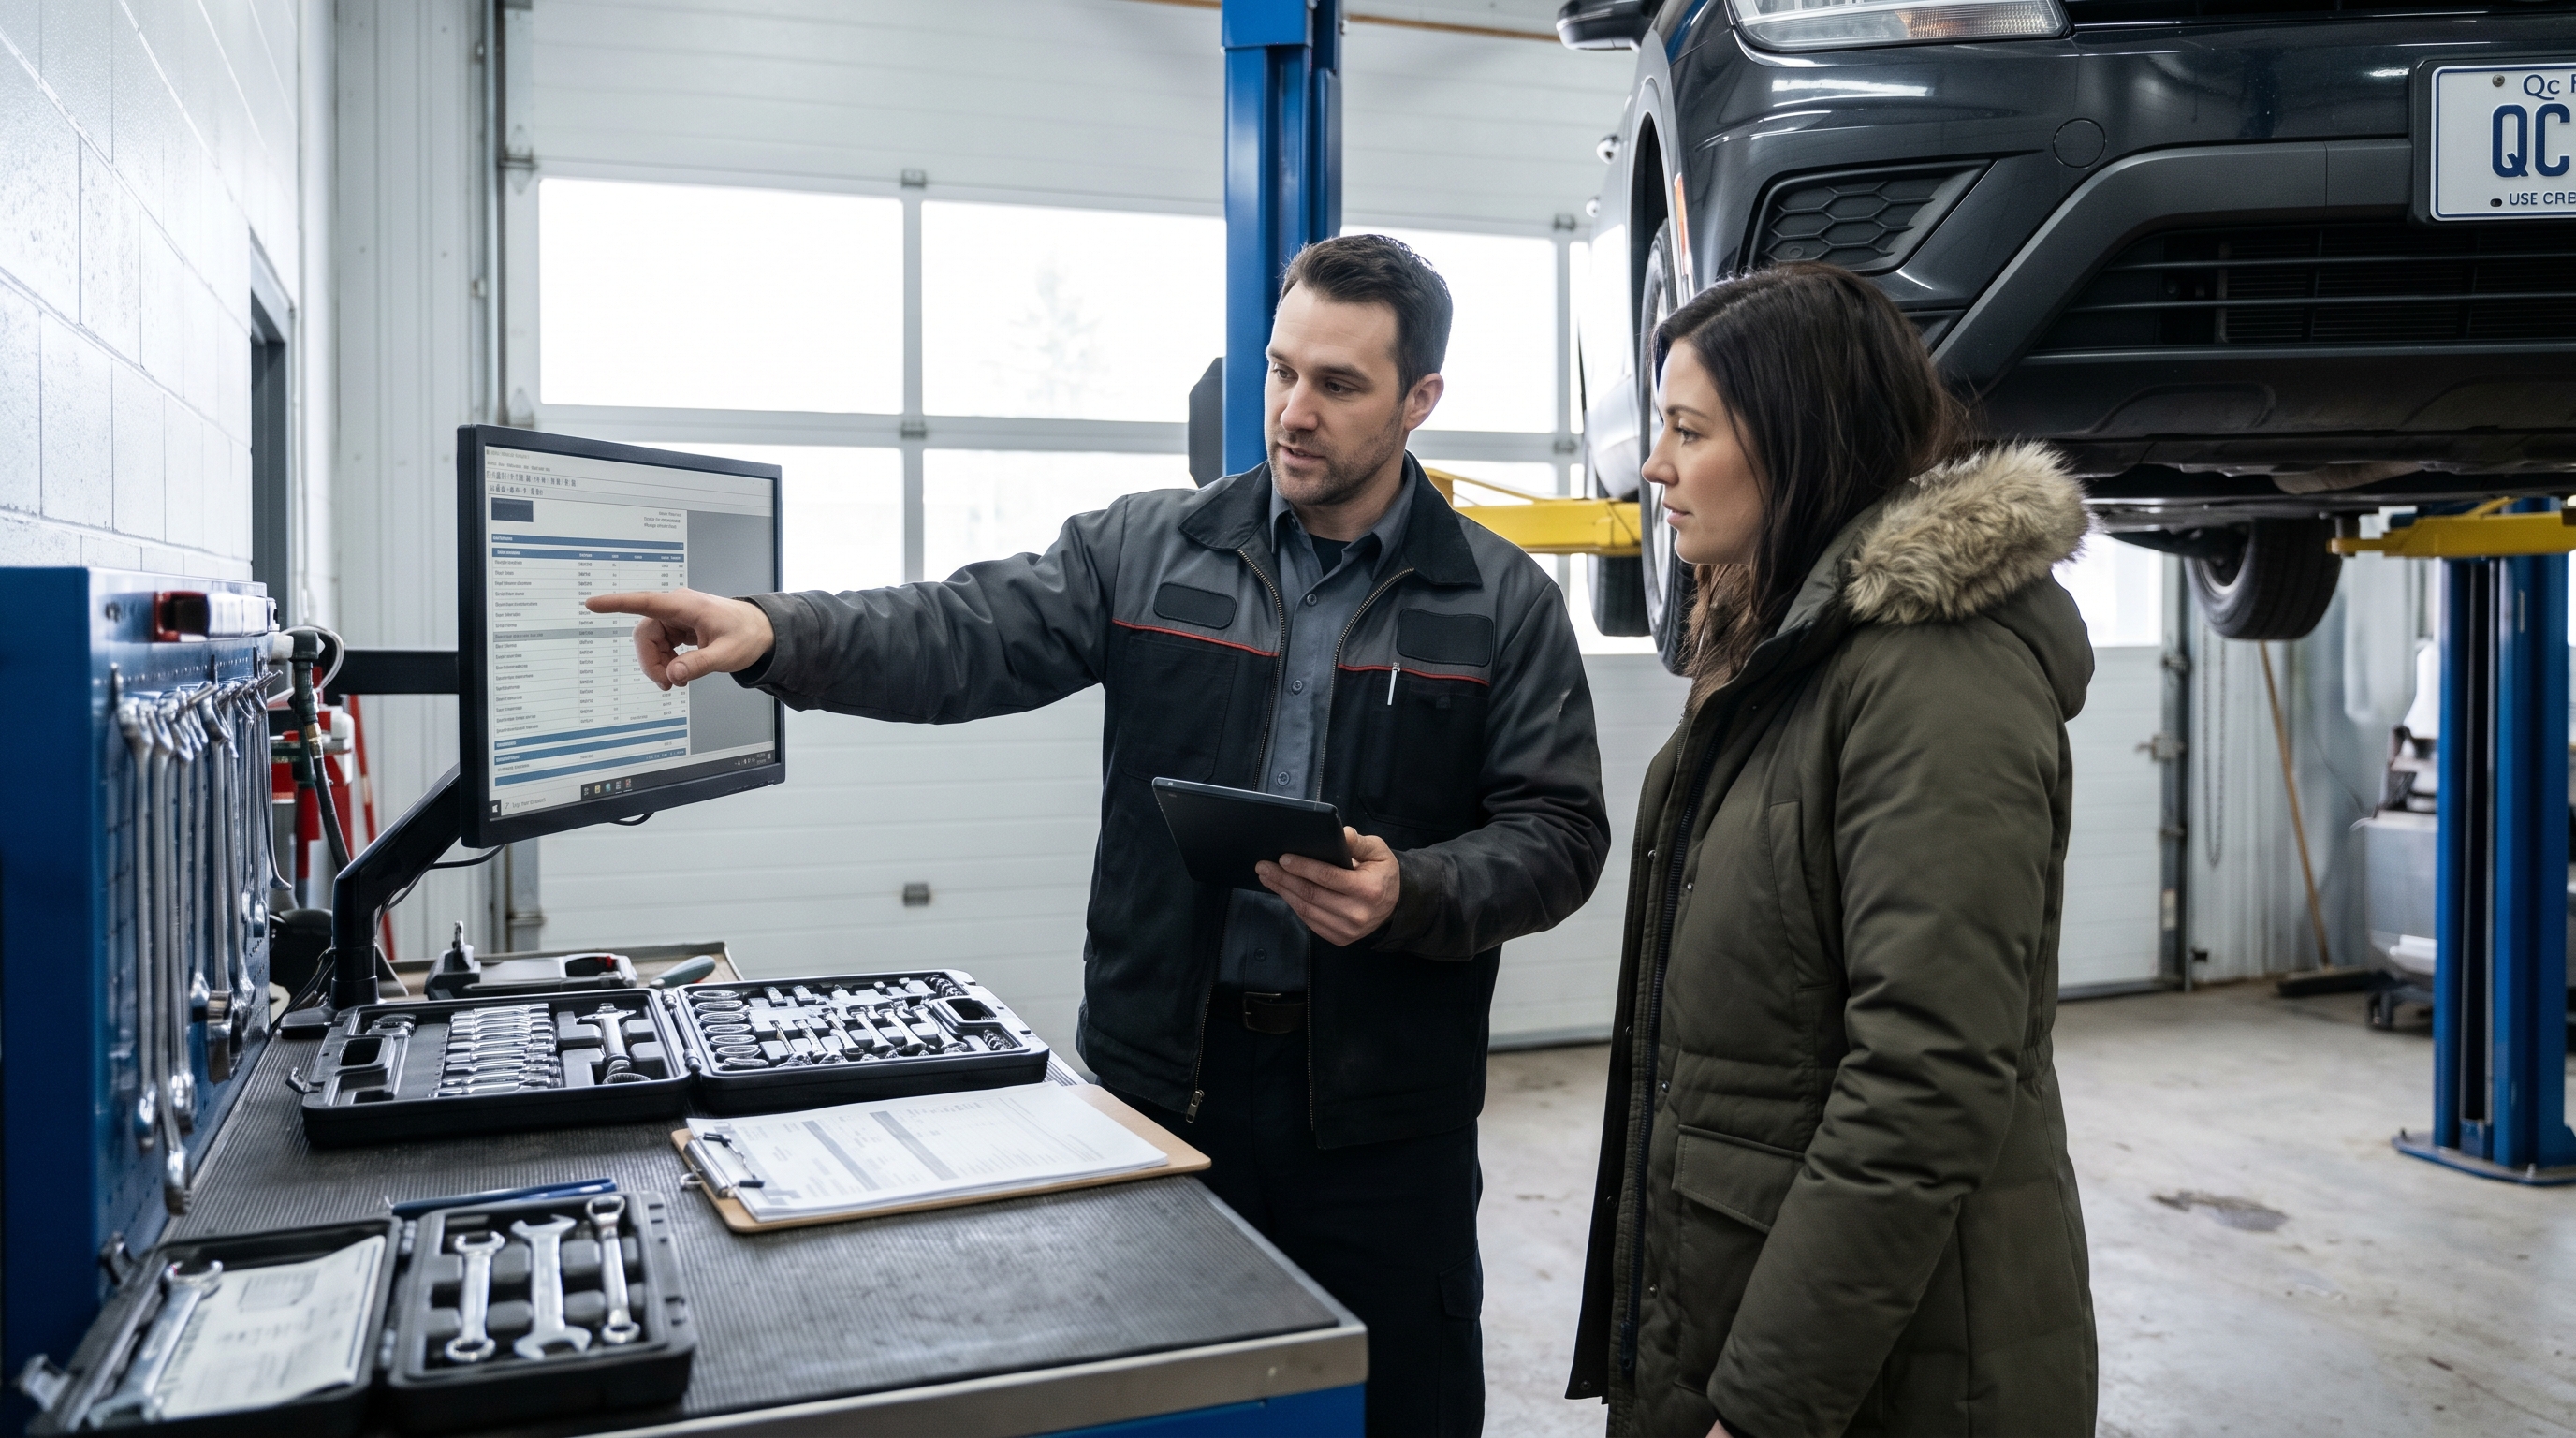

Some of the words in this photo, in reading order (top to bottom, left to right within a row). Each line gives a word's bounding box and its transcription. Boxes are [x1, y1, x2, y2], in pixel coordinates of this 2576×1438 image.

[2523, 74, 2560, 100] Qc
[2492, 103, 2571, 178] QC
[2509, 192, 2539, 205] USE
